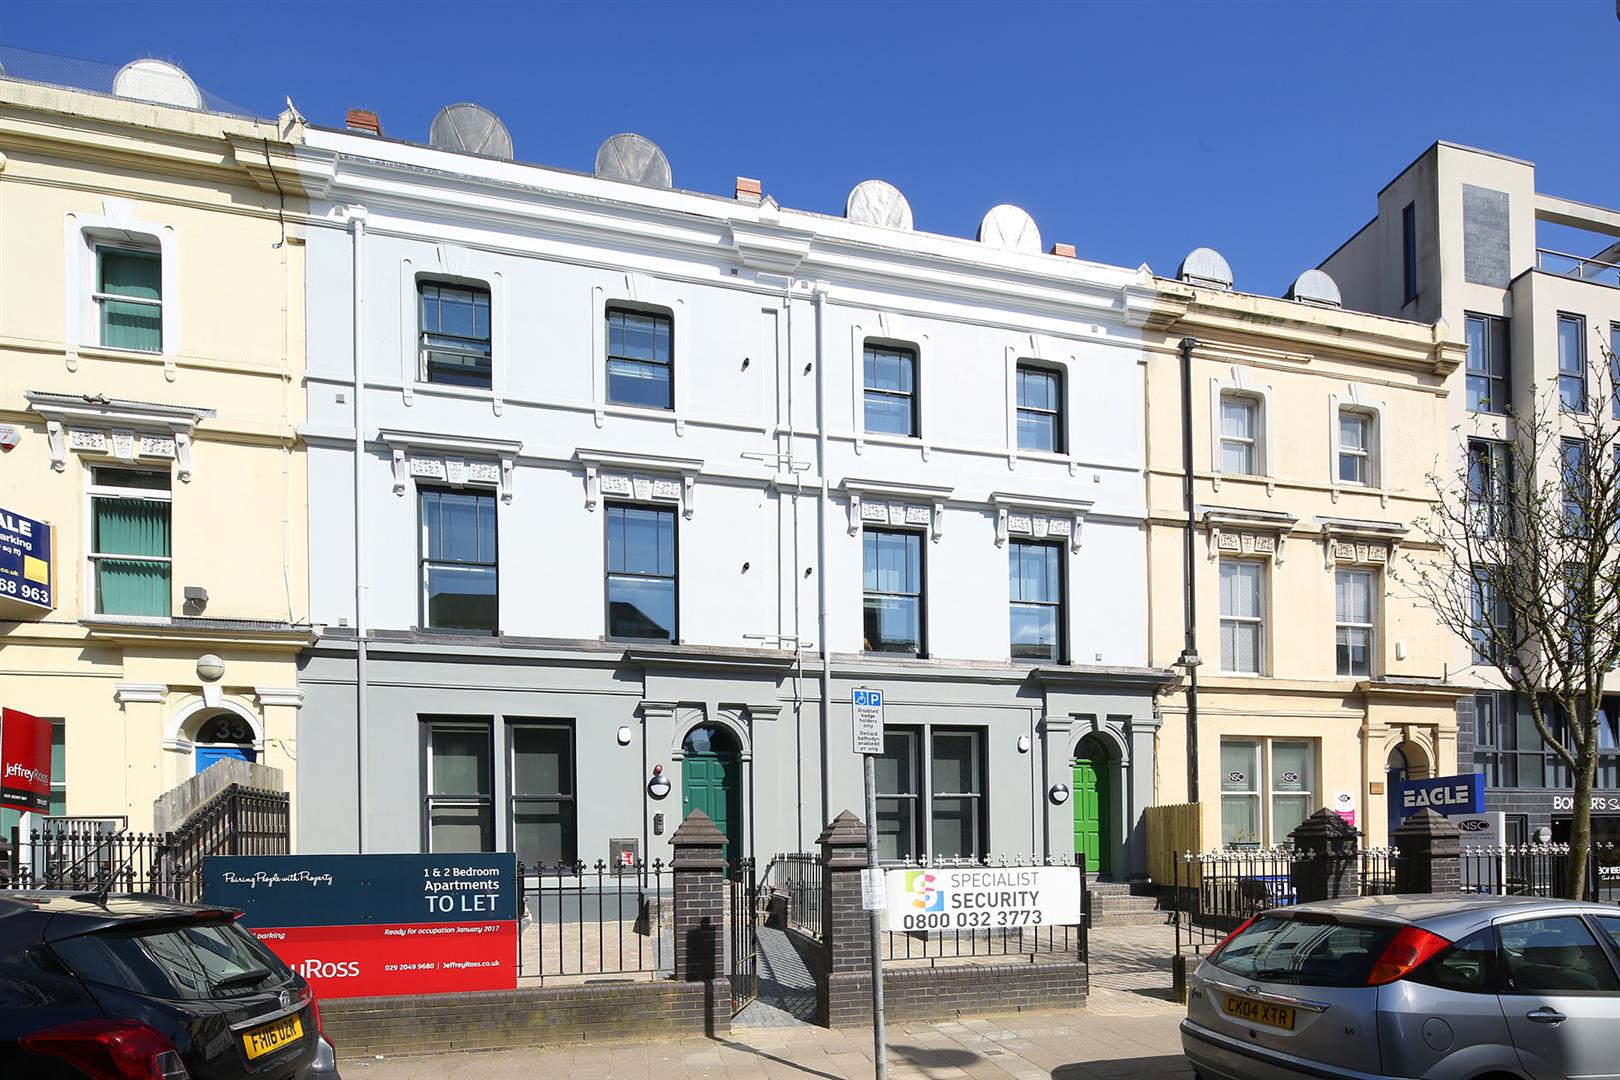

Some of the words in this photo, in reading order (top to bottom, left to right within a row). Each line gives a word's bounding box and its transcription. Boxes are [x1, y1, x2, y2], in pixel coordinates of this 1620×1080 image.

[21, 584, 48, 603] 963
[871, 694, 879, 705] P
[215, 720, 245, 739] 33
[5, 763, 48, 784] JeffreyRoss
[1403, 785, 1469, 807] EAGLE
[1461, 821, 1489, 832] NSC
[223, 872, 255, 888] Pairing
[254, 871, 281, 887] People
[281, 873, 300, 882] with
[298, 870, 333, 886] Property
[424, 868, 430, 877] 1
[432, 868, 441, 877] &
[444, 868, 450, 877] 2
[453, 867, 500, 877] Bedroom
[951, 872, 1039, 888] SPECIALIST
[424, 880, 500, 893] Apartments
[425, 895, 454, 913] TO
[461, 894, 500, 912] LET
[951, 891, 1040, 909] SECURITY
[903, 913, 950, 930] 0800
[956, 912, 991, 927] 032
[997, 910, 1042, 926] 3773
[384, 928, 406, 937] Ready
[407, 927, 417, 935] for
[417, 926, 455, 934] occupation
[456, 925, 482, 934] January
[399, 963, 416, 971] 2049
[443, 960, 500, 969] JeffreyRoss.co.uk
[1227, 998, 1258, 1018] CK04
[1262, 1005, 1287, 1026] XTR
[252, 1024, 278, 1053] FH16
[278, 1017, 297, 1041] UZR
